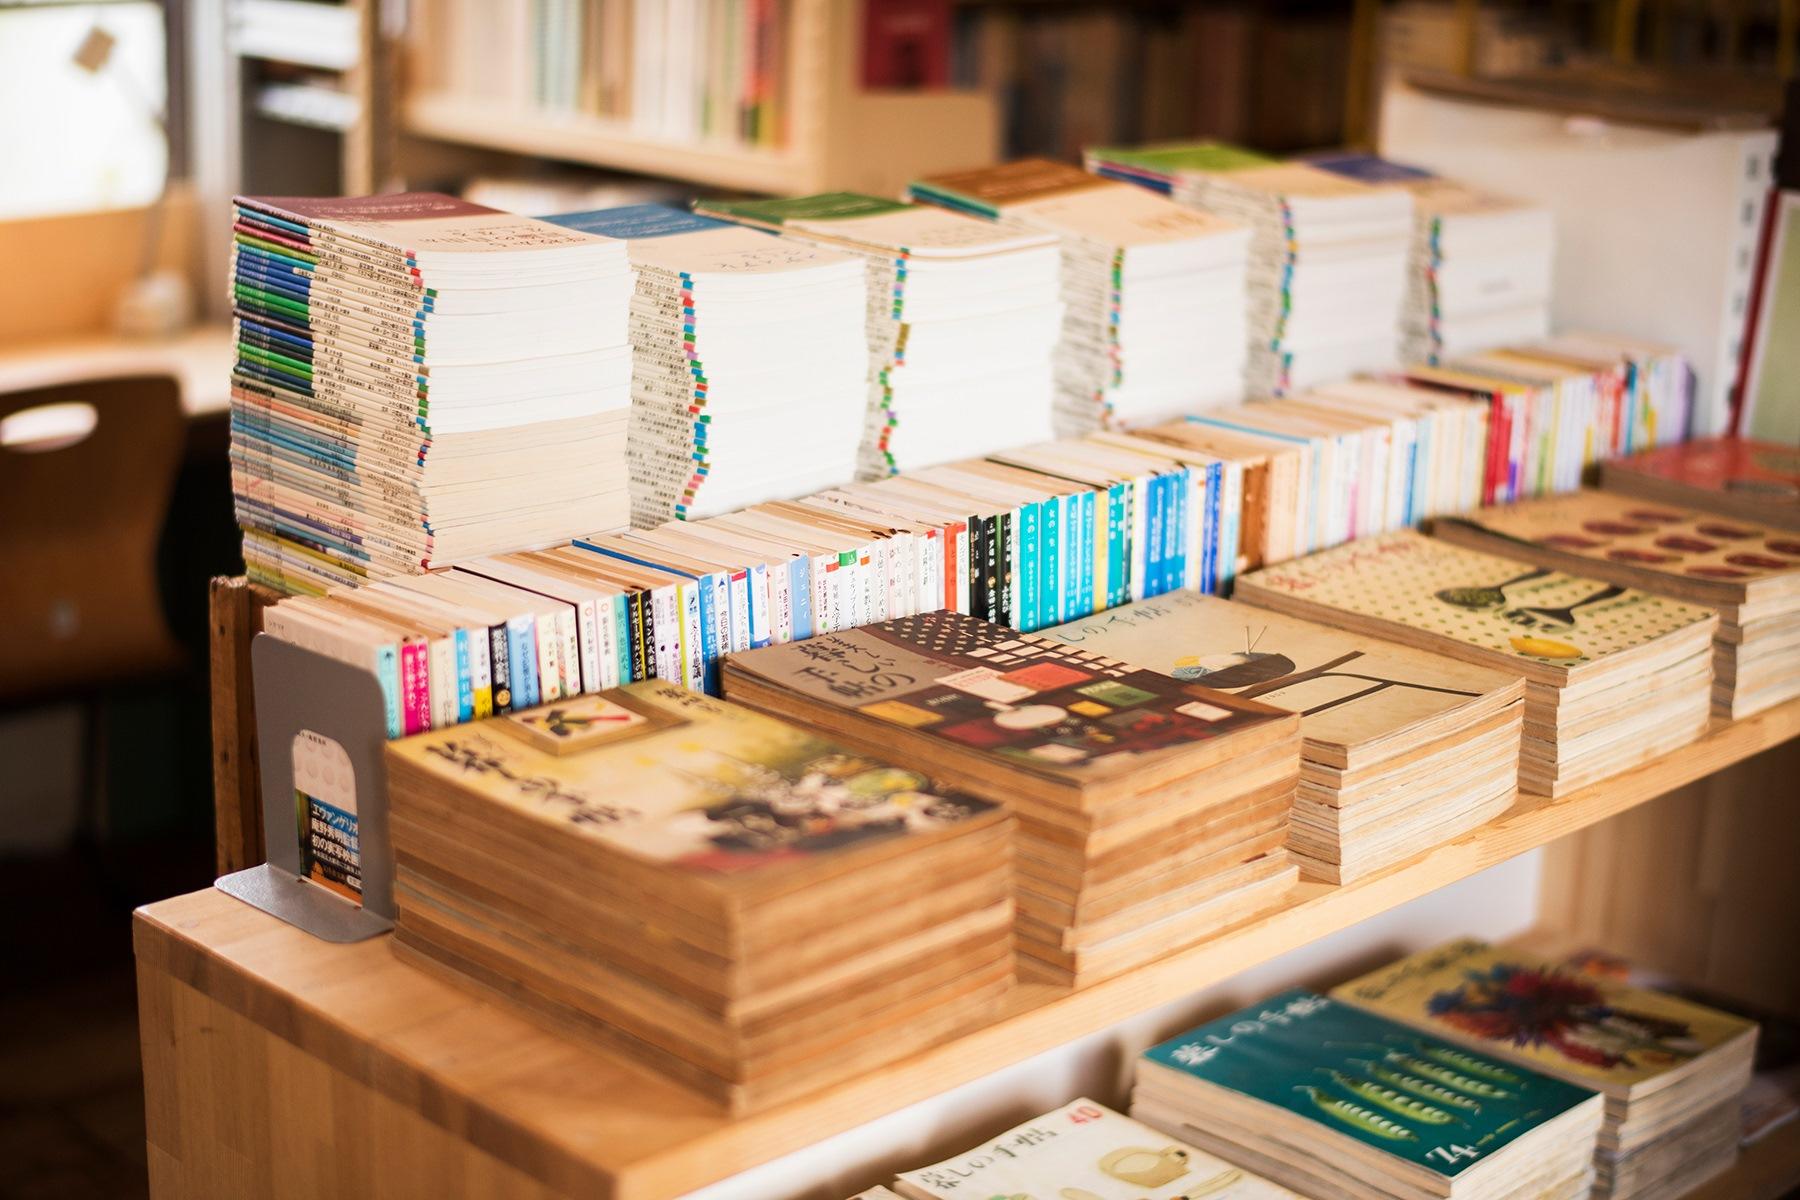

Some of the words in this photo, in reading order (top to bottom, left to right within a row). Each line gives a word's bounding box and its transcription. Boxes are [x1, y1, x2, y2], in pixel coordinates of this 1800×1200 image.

[1056, 605, 1172, 642] しの手帖
[1066, 1105, 1105, 1126] 40
[918, 1126, 1059, 1191] 暮しの手帖
[1425, 1143, 1481, 1164] 74
